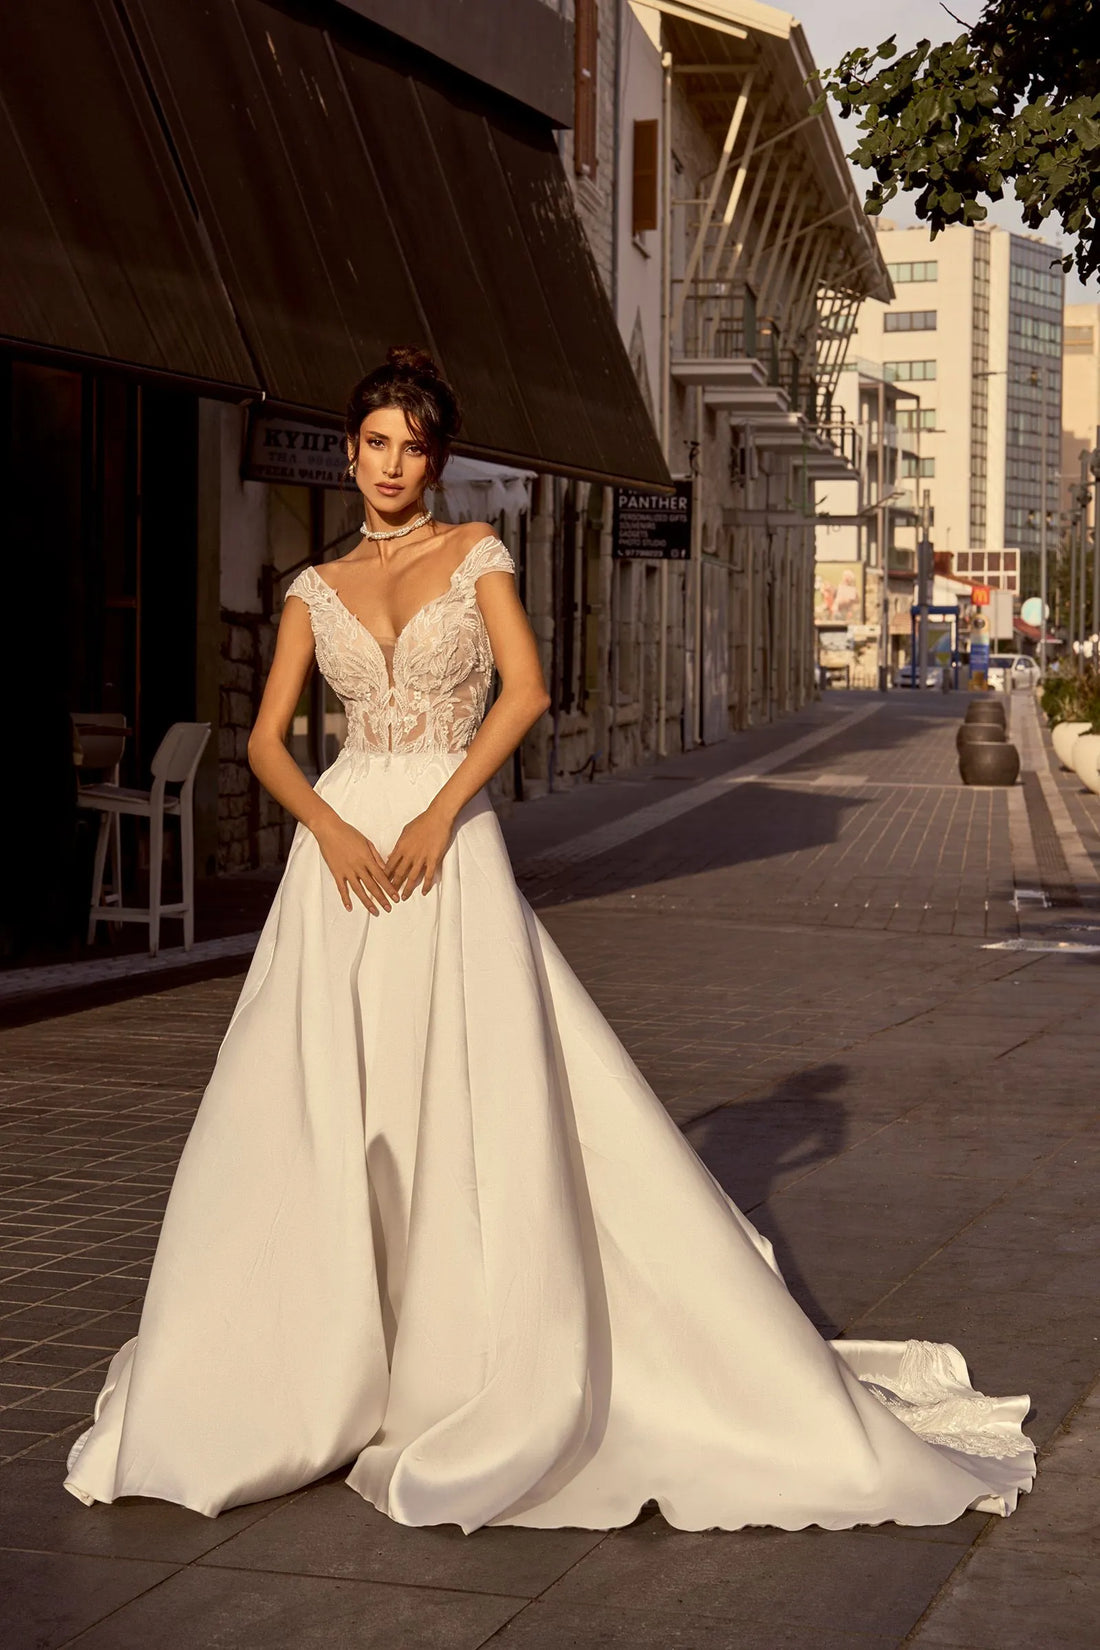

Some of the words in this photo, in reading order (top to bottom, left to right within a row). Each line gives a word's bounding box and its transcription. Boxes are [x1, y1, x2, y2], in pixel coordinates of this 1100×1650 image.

[618, 495, 688, 510] PANTHER
[669, 514, 688, 522] GIFTS
[618, 538, 641, 546] PHOTO
[642, 539, 667, 547] STUDIO
